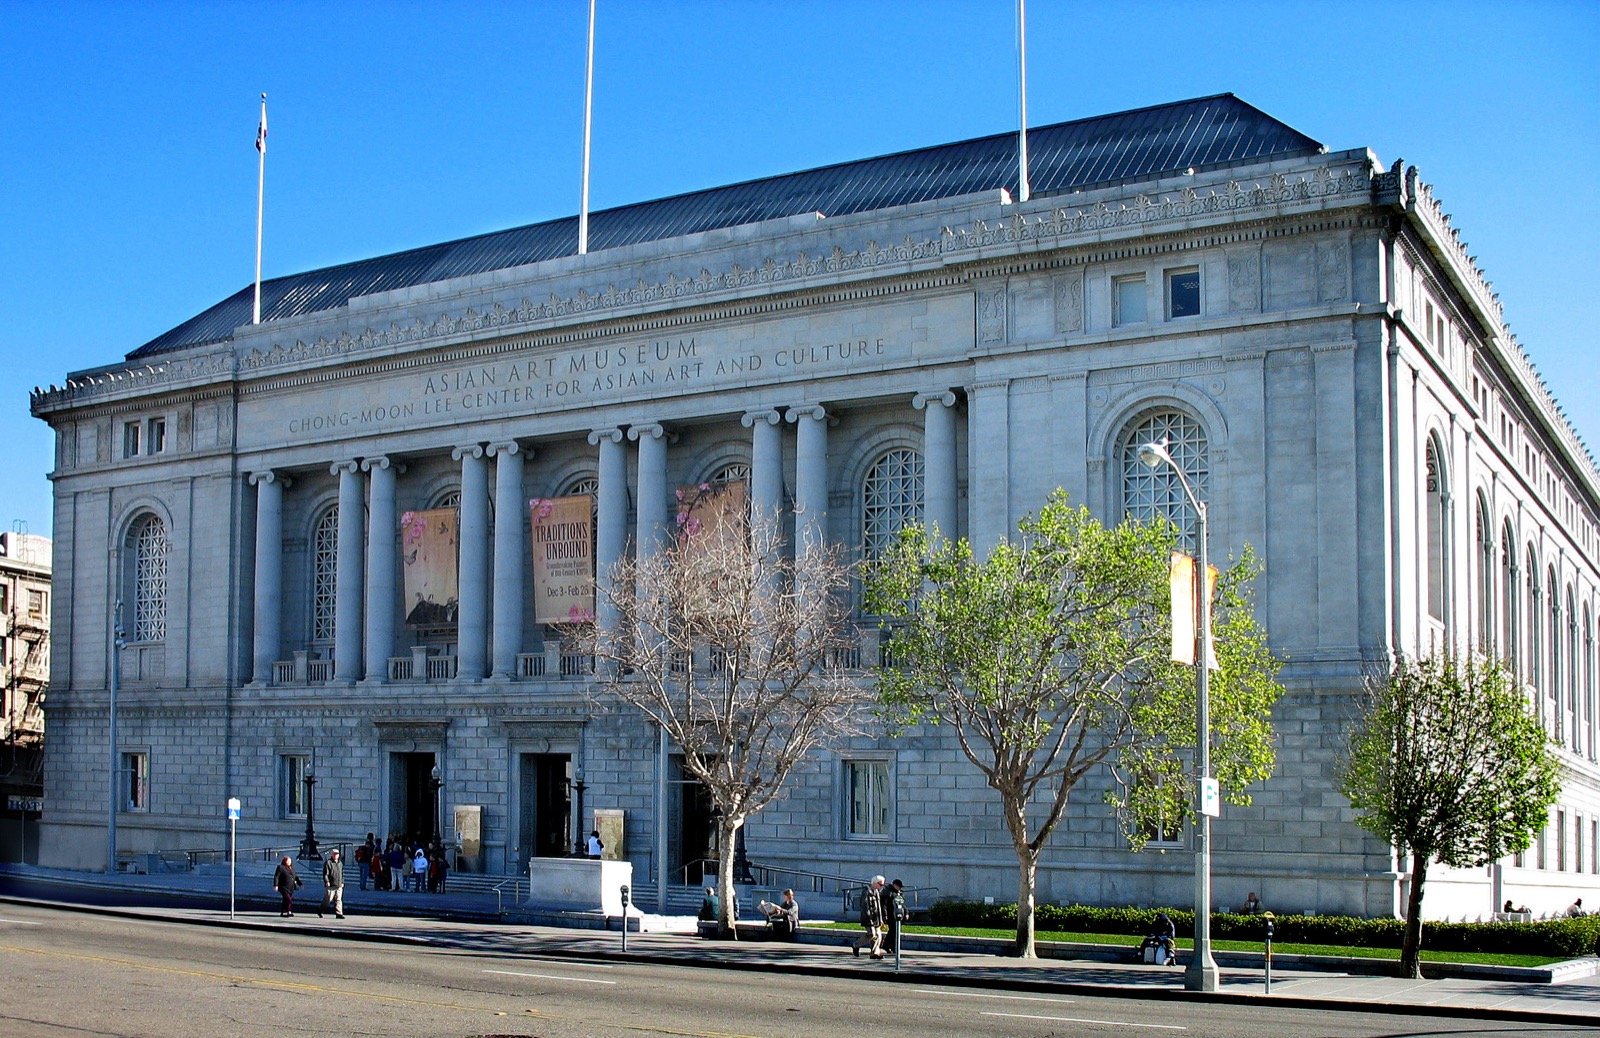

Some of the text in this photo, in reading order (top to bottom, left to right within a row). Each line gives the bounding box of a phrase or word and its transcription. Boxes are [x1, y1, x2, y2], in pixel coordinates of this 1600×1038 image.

[424, 337, 697, 395] ASIAN ART MUSEUM
[288, 338, 884, 433] CHONG-MOON LEE CENTER FOR ASIAN ART AND CULTURE
[535, 522, 588, 542] TRADITIONS
[546, 541, 588, 559] UNBOUND
[547, 587, 559, 597] Dec
[559, 586, 564, 597] 3
[567, 585, 580, 596] Feb
